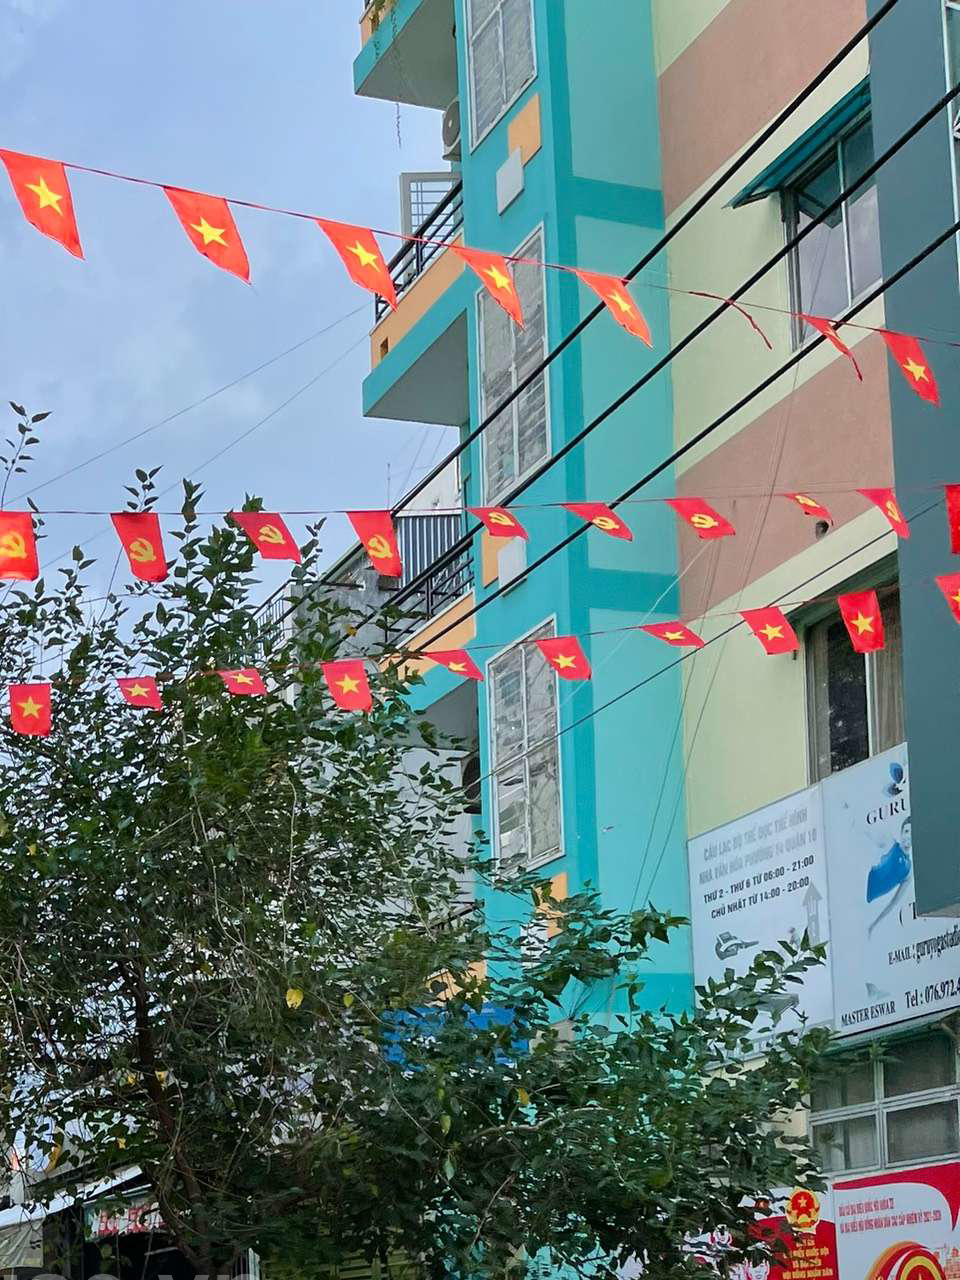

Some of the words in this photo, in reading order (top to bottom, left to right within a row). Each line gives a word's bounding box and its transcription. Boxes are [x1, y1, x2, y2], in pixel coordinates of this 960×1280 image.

[792, 855, 814, 872] 21:00
[760, 887, 780, 902] 14:00
[787, 876, 809, 893] 20:00
[841, 1006, 869, 1028] MASTER
[870, 1000, 896, 1021] ESWAR
